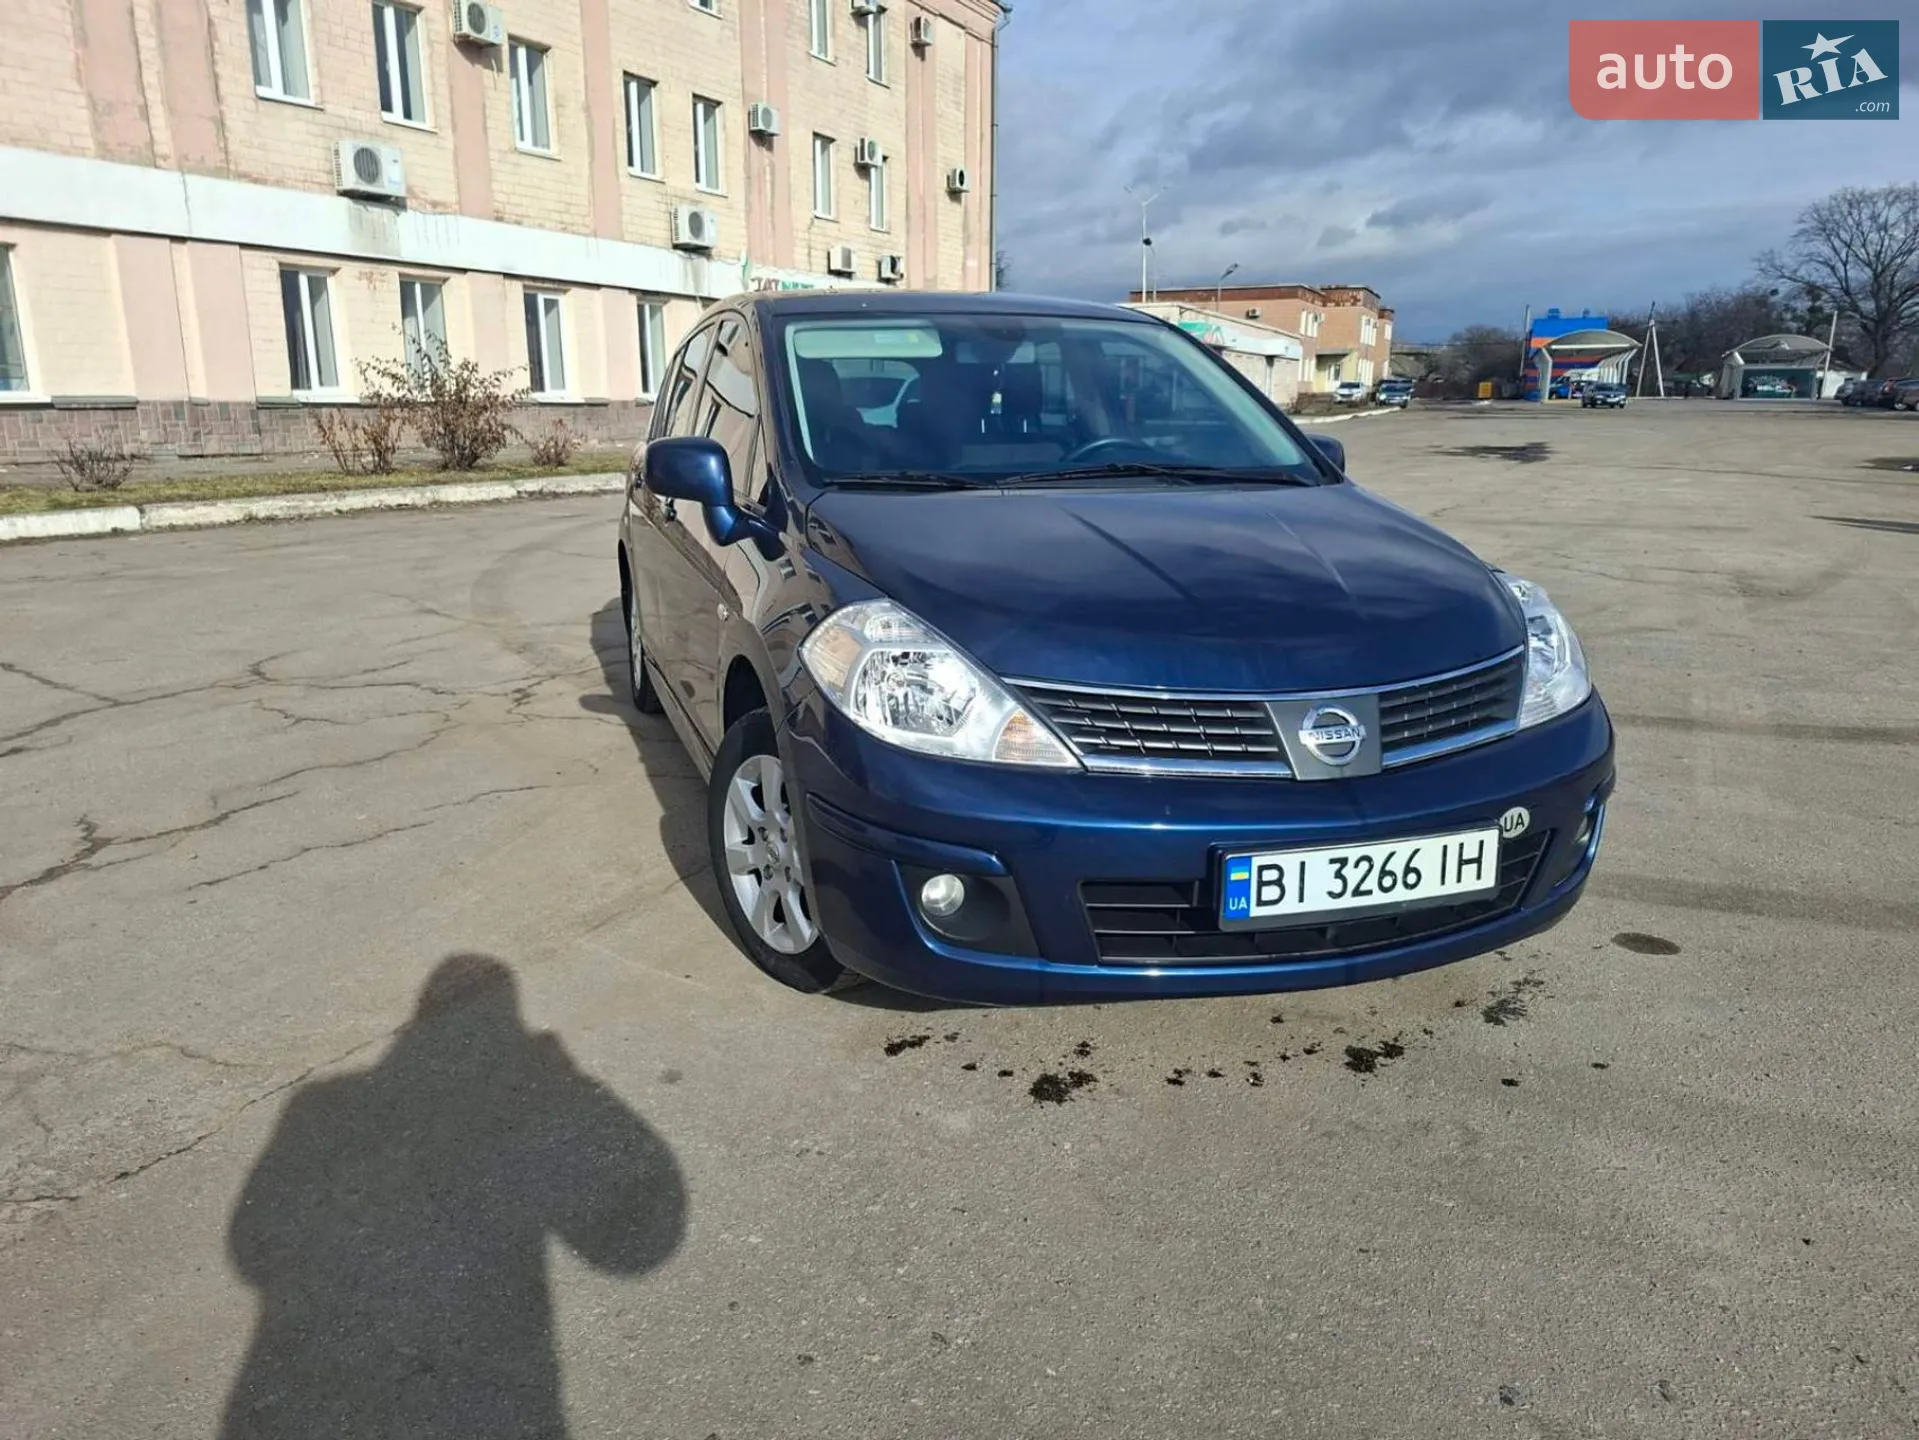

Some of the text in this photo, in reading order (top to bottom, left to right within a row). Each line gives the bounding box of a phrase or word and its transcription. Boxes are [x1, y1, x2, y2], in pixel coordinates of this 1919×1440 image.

[1307, 727, 1361, 741] NISSAN
[1503, 812, 1526, 834] UA
[1256, 839, 1485, 908] BI 3266 IH
[1229, 900, 1248, 912] UA
